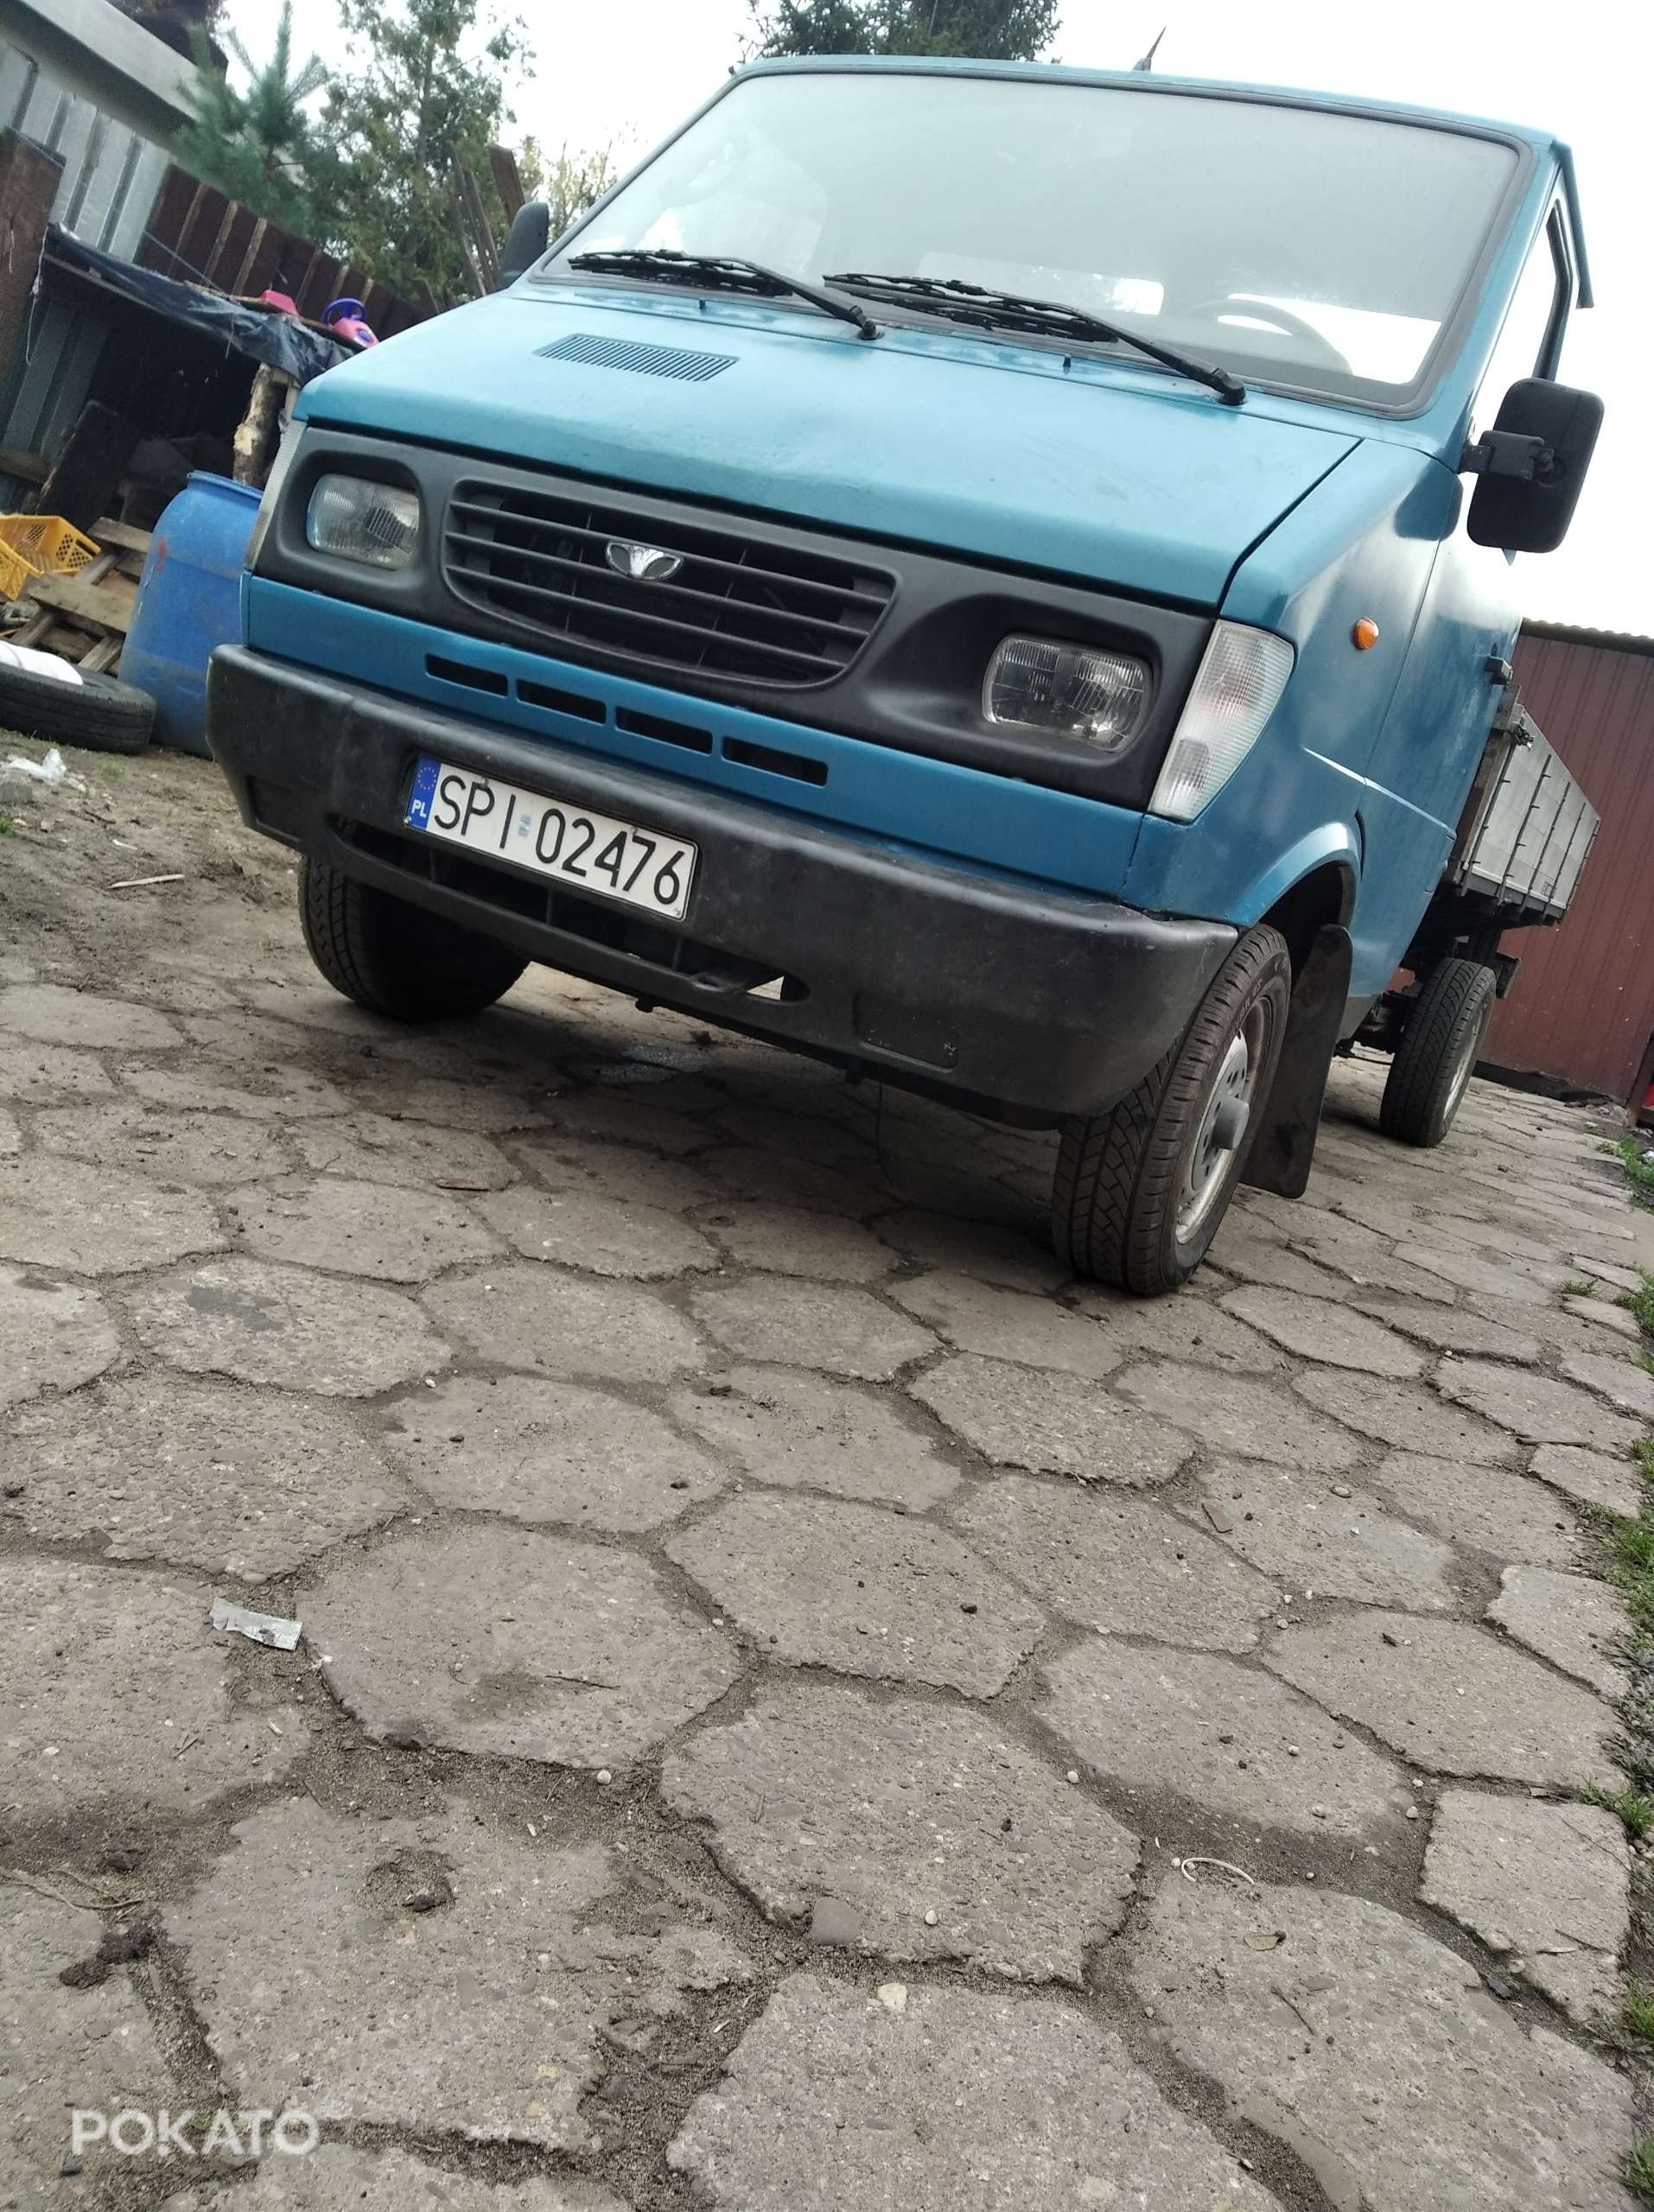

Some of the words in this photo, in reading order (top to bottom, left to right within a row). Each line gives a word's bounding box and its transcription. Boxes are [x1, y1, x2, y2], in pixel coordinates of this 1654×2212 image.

[411, 799, 427, 818] PL
[435, 775, 516, 849] SPI
[535, 808, 685, 906] 02476
